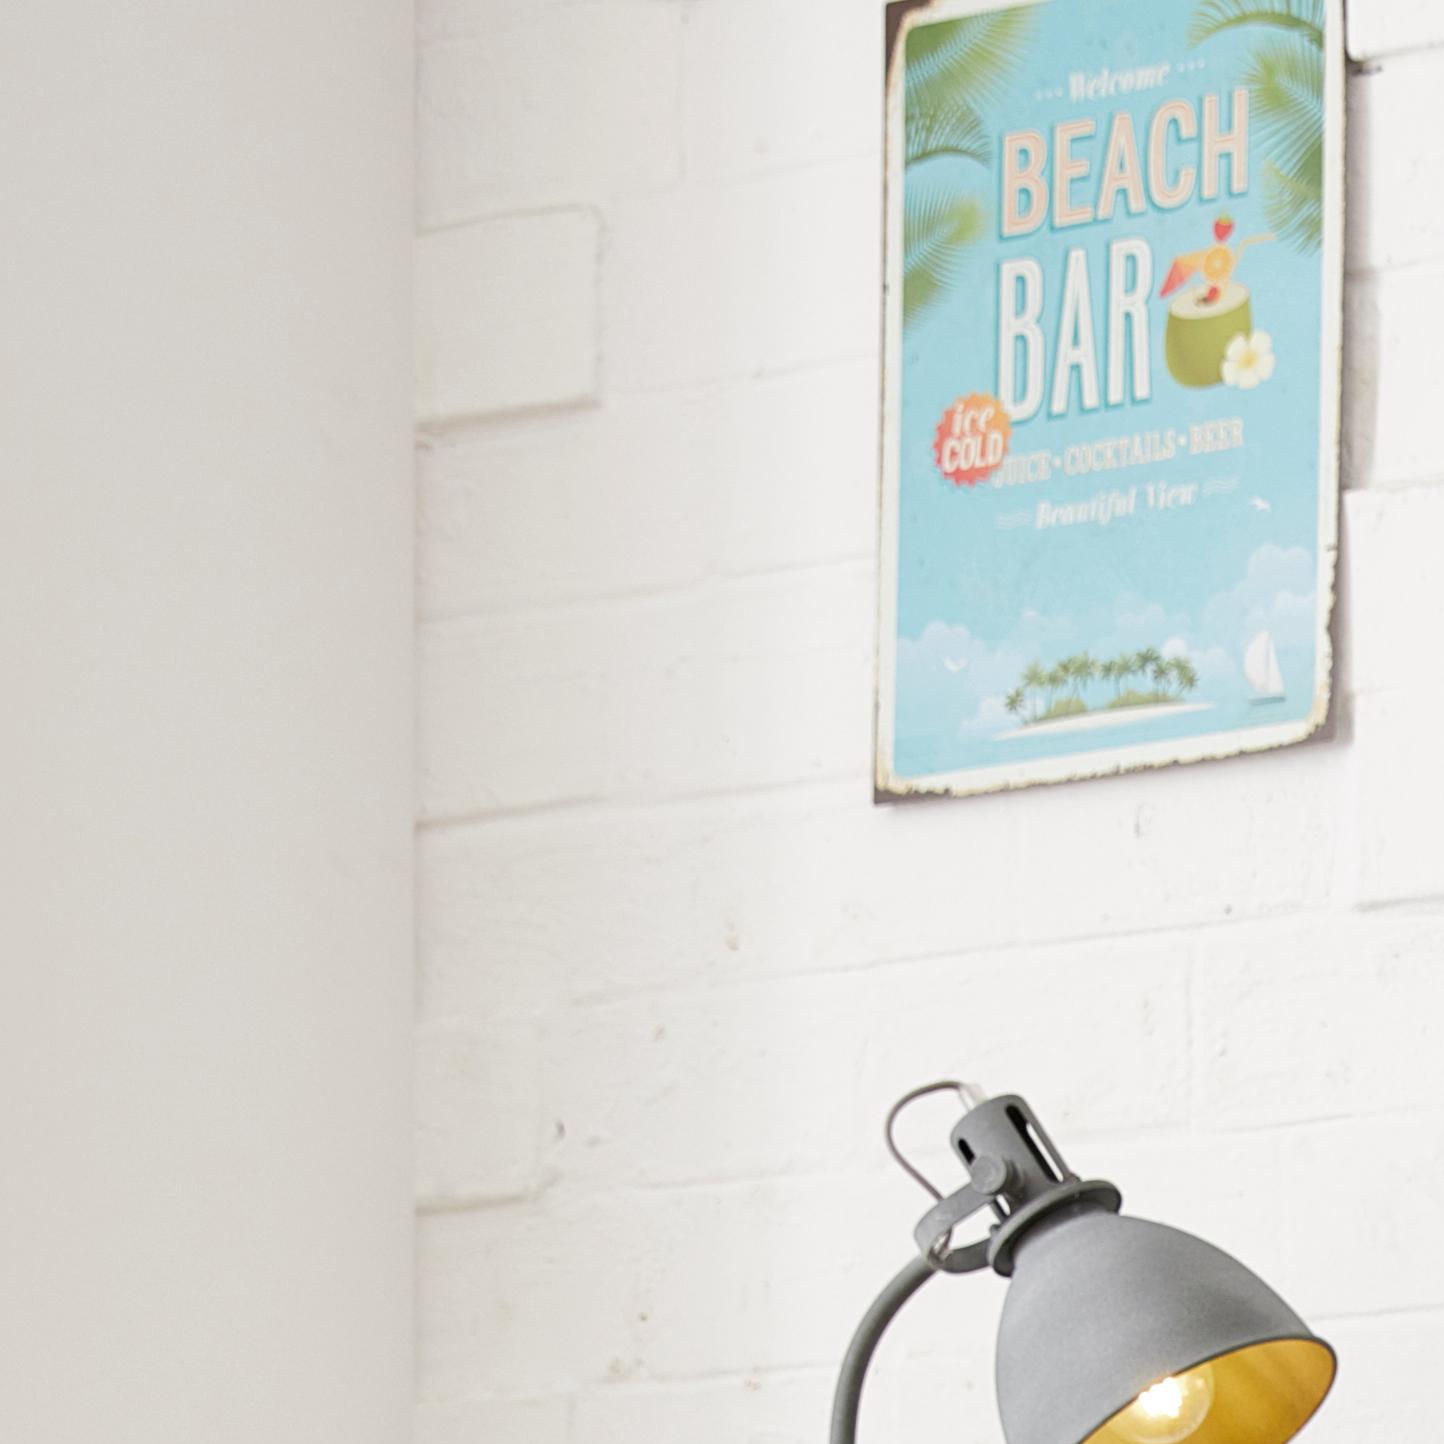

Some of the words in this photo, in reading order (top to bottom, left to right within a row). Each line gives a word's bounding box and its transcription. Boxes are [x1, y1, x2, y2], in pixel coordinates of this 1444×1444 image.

[1069, 60, 1170, 102] Welcome
[1001, 87, 1250, 239] BEACH
[998, 237, 1154, 422] BAR
[951, 403, 994, 437] ice
[1189, 416, 1244, 455] BEER
[942, 431, 1003, 474] COLD
